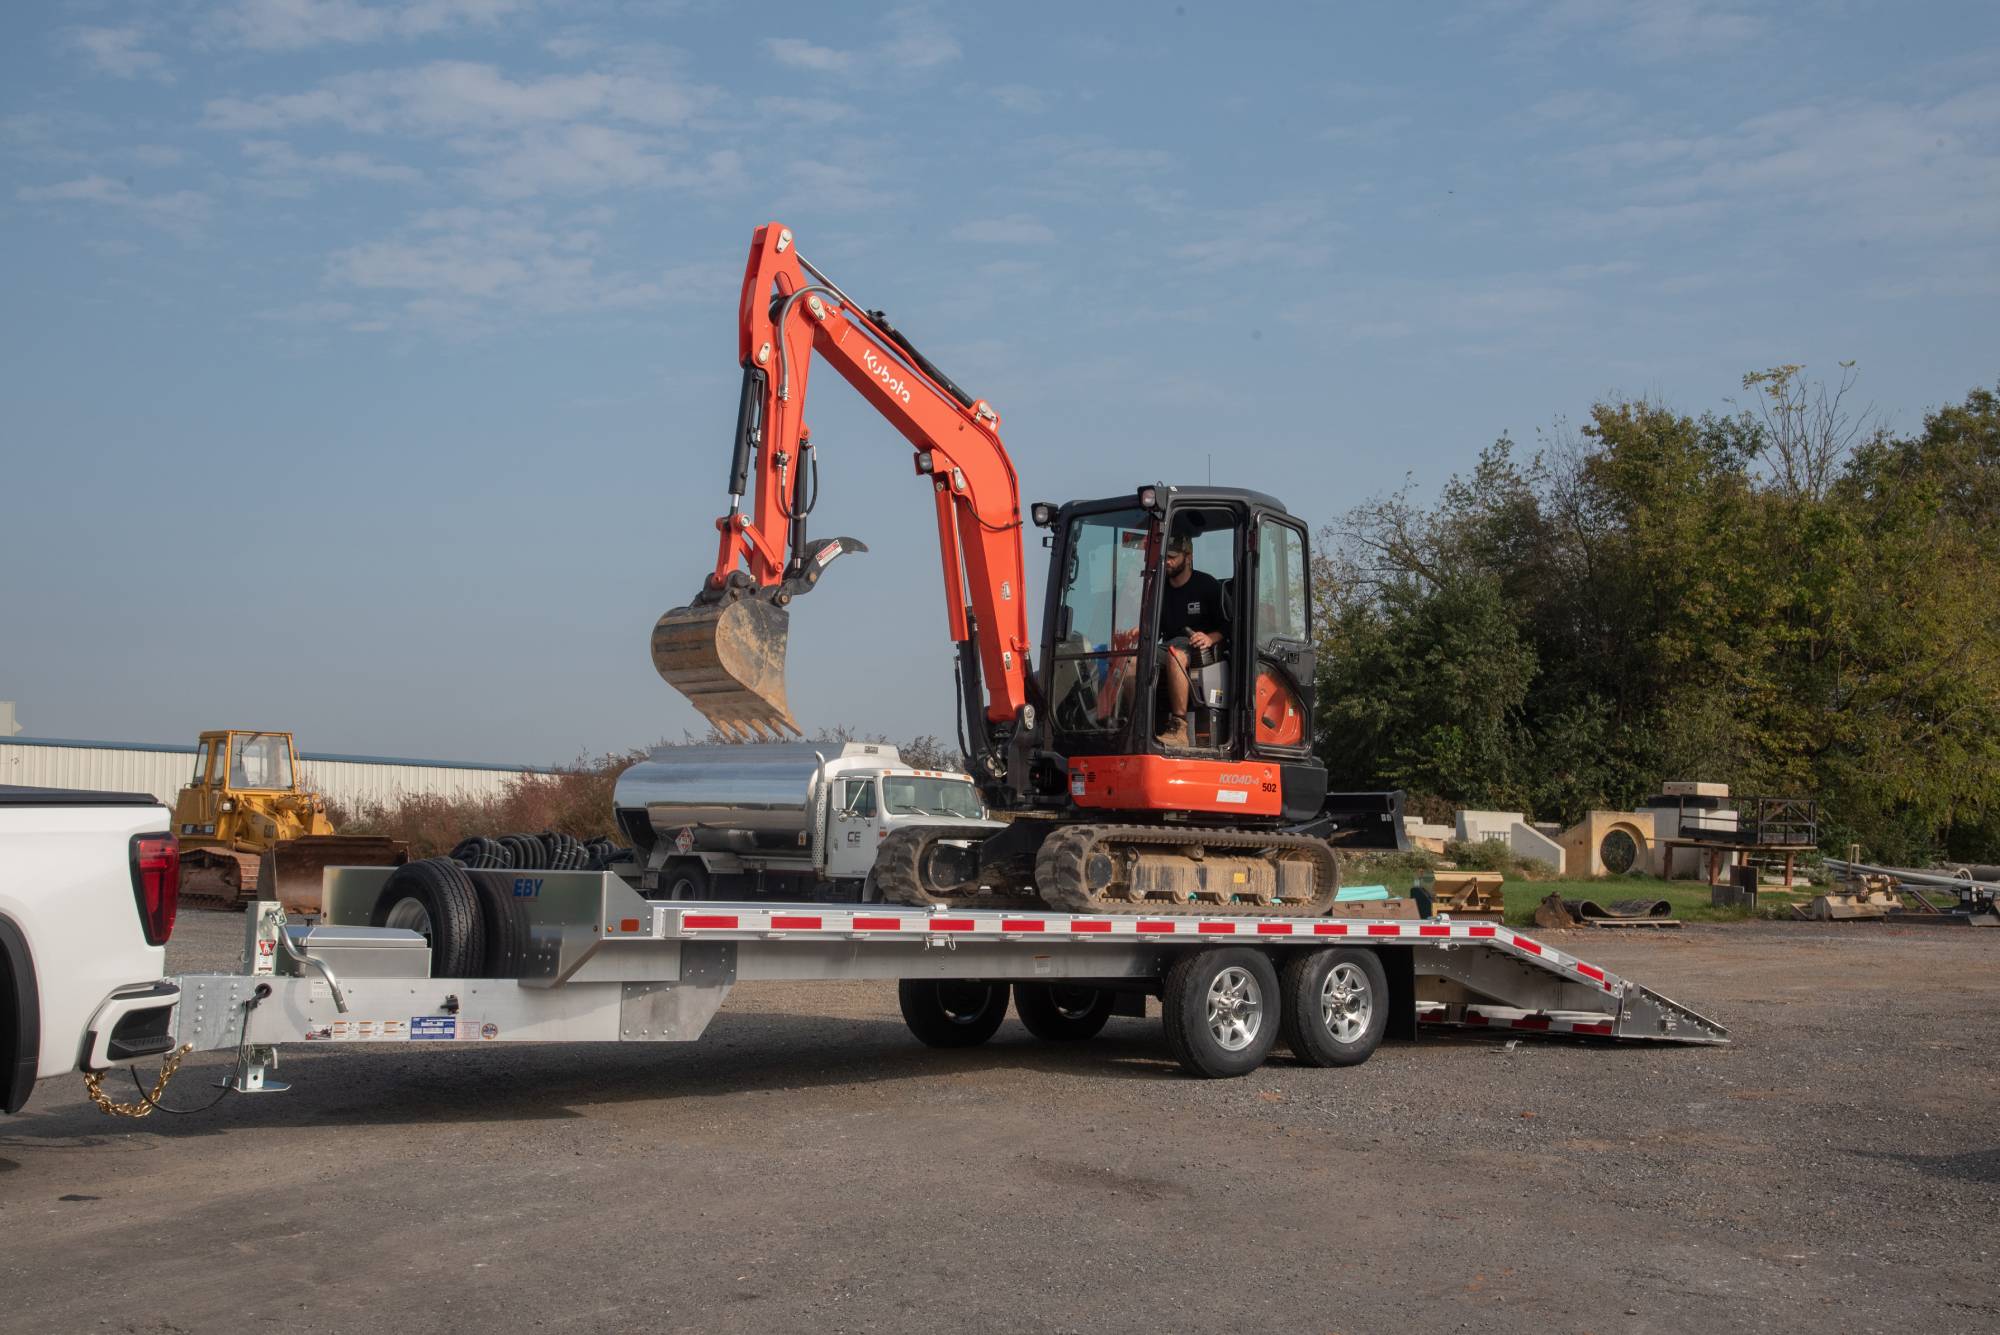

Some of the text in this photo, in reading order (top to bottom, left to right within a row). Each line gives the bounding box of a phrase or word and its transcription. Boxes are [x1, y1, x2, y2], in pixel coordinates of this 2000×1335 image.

[863, 349, 911, 404] Kubota
[1261, 782, 1278, 793] 502
[847, 831, 862, 842] CE
[513, 878, 545, 897] EBY
